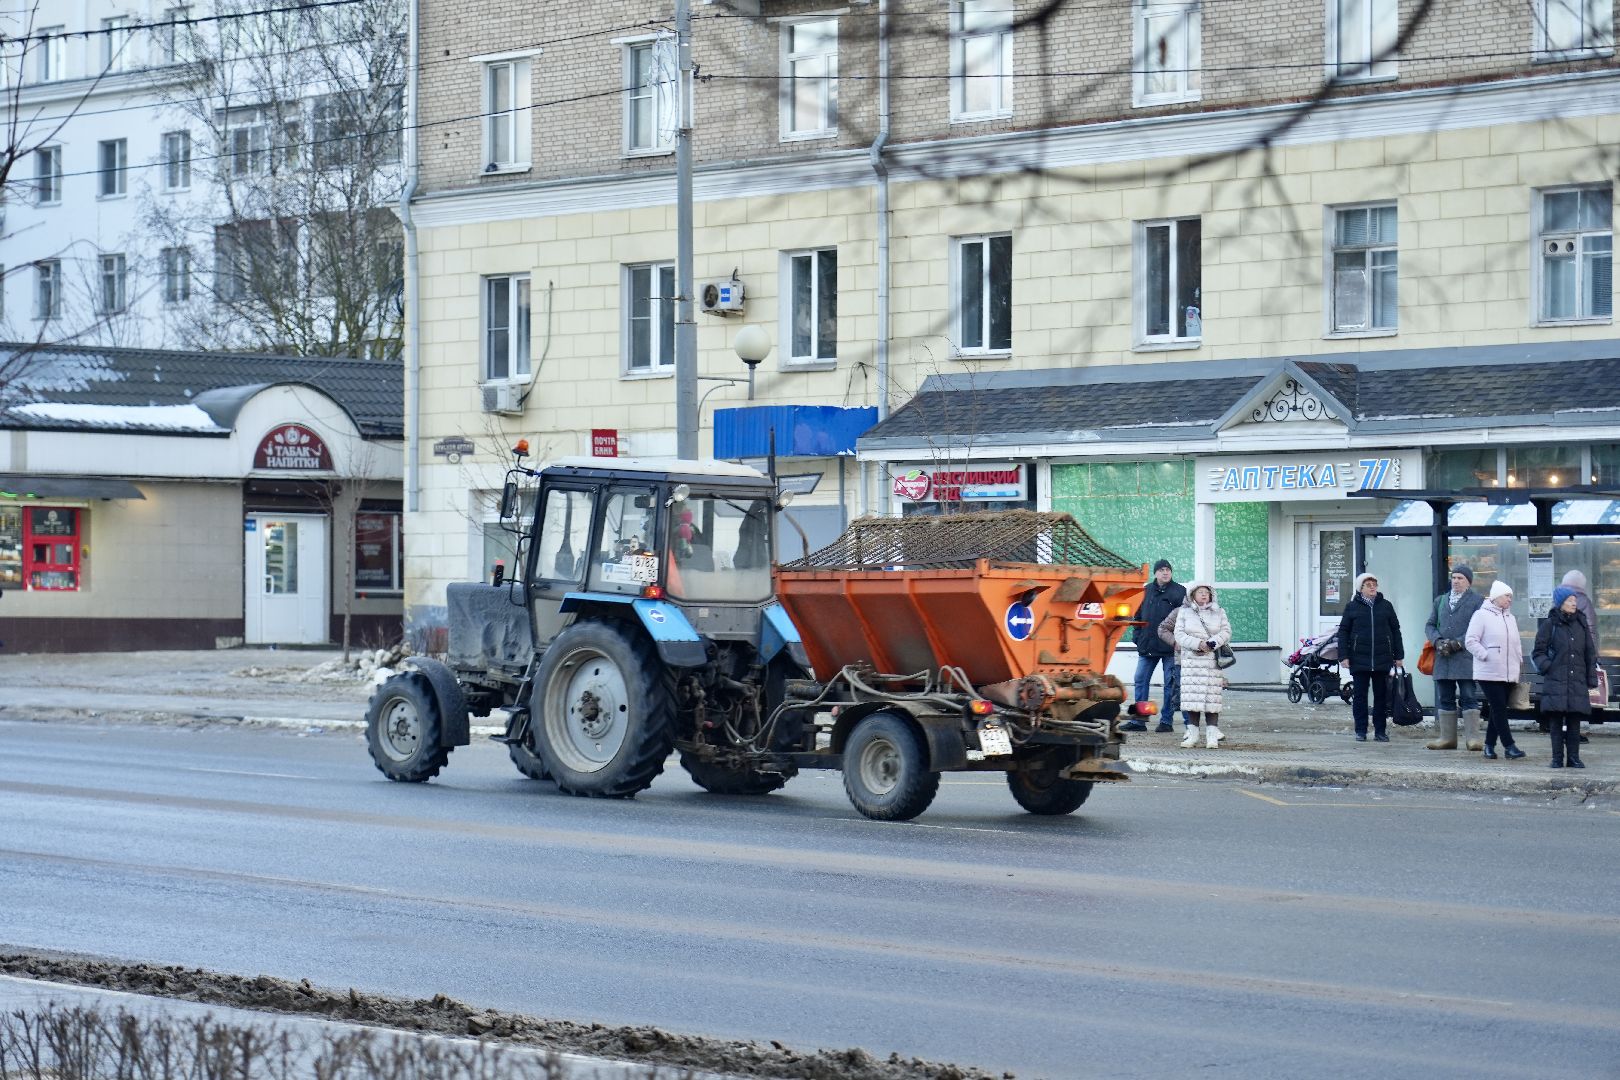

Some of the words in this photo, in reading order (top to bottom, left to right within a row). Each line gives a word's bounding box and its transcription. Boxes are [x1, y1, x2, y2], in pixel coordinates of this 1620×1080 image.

[594, 436, 616, 446] ПОЧТА
[274, 446, 310, 457] ТАБАК
[594, 446, 613, 455] БАНК
[266, 457, 320, 468] НАПИТКИ
[1223, 464, 1337, 491] АПТЕКА
[1358, 458, 1391, 490] 71
